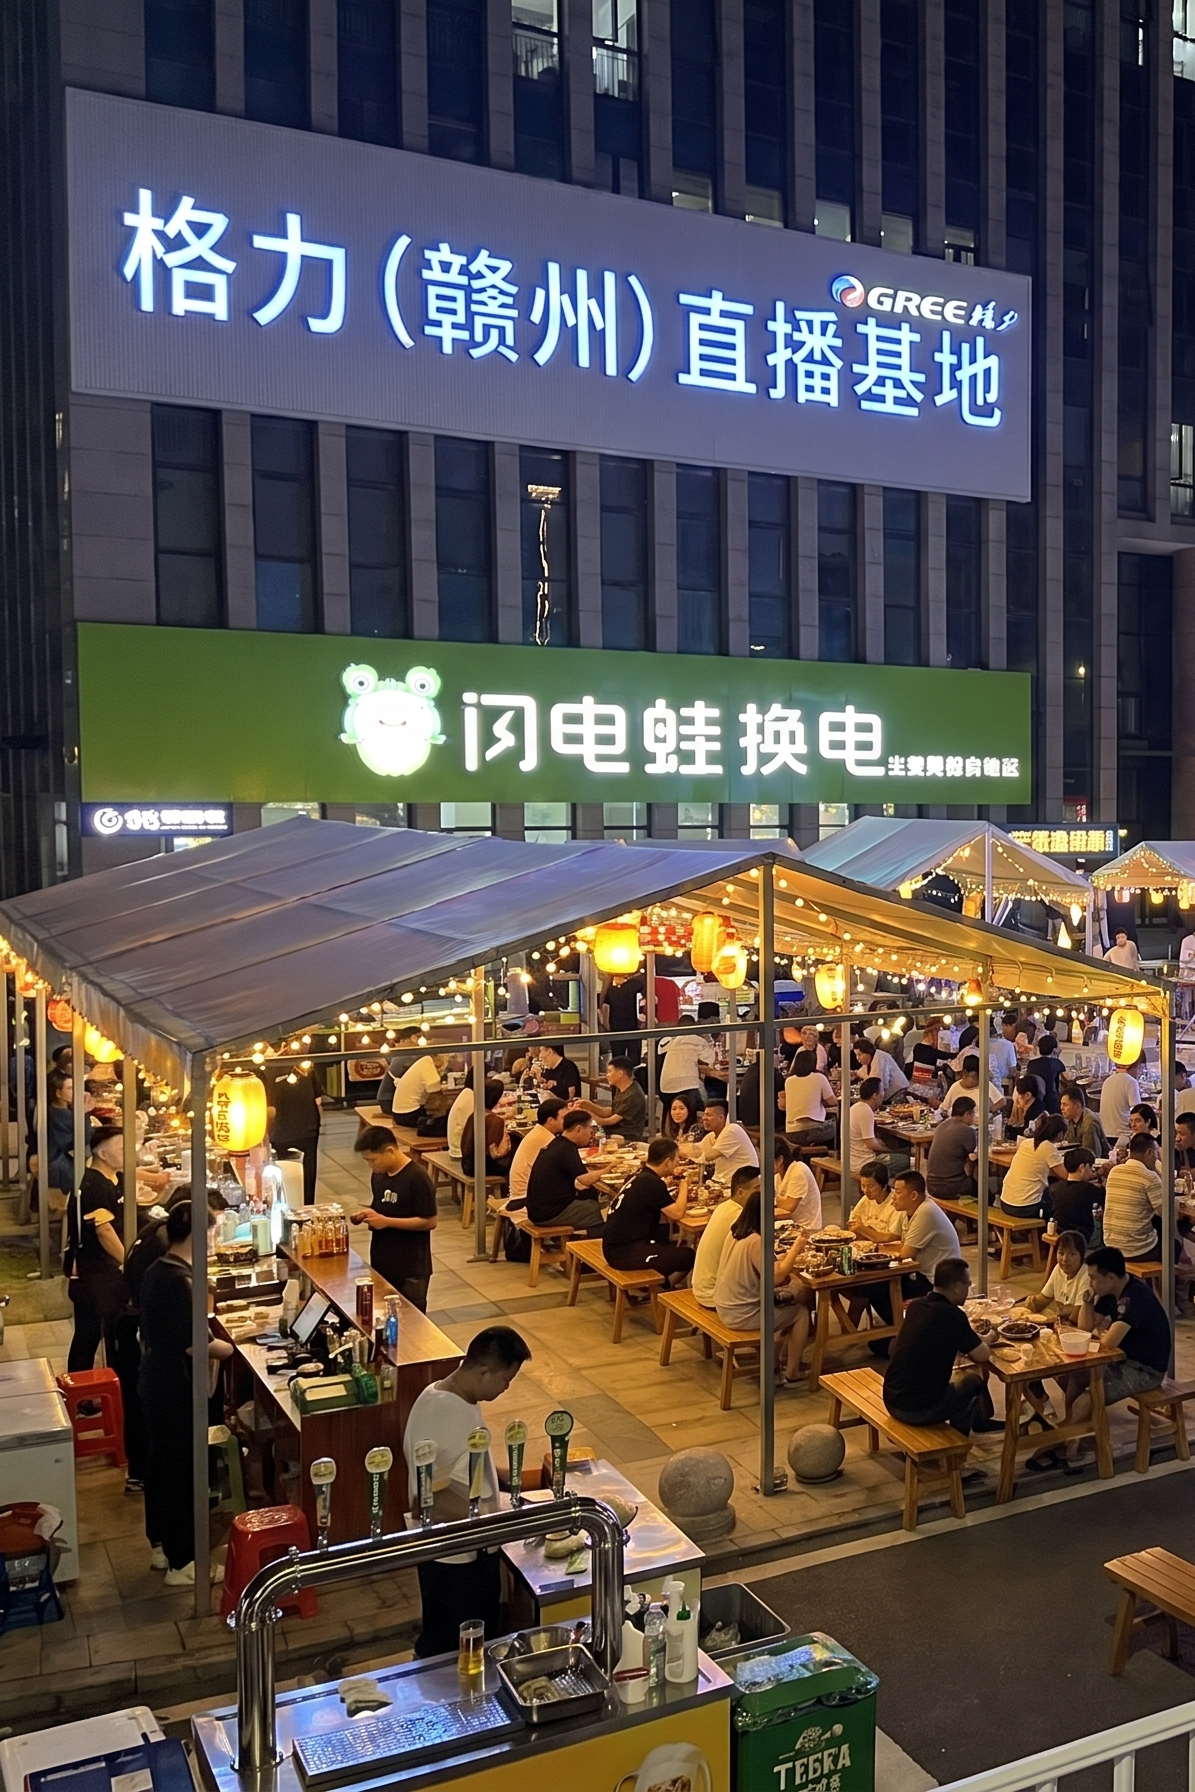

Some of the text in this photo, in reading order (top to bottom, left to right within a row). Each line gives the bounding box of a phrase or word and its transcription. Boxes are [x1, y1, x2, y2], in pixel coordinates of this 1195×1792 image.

[867, 286, 968, 325] GREE
[462, 691, 886, 777] 闪电蛙换电
